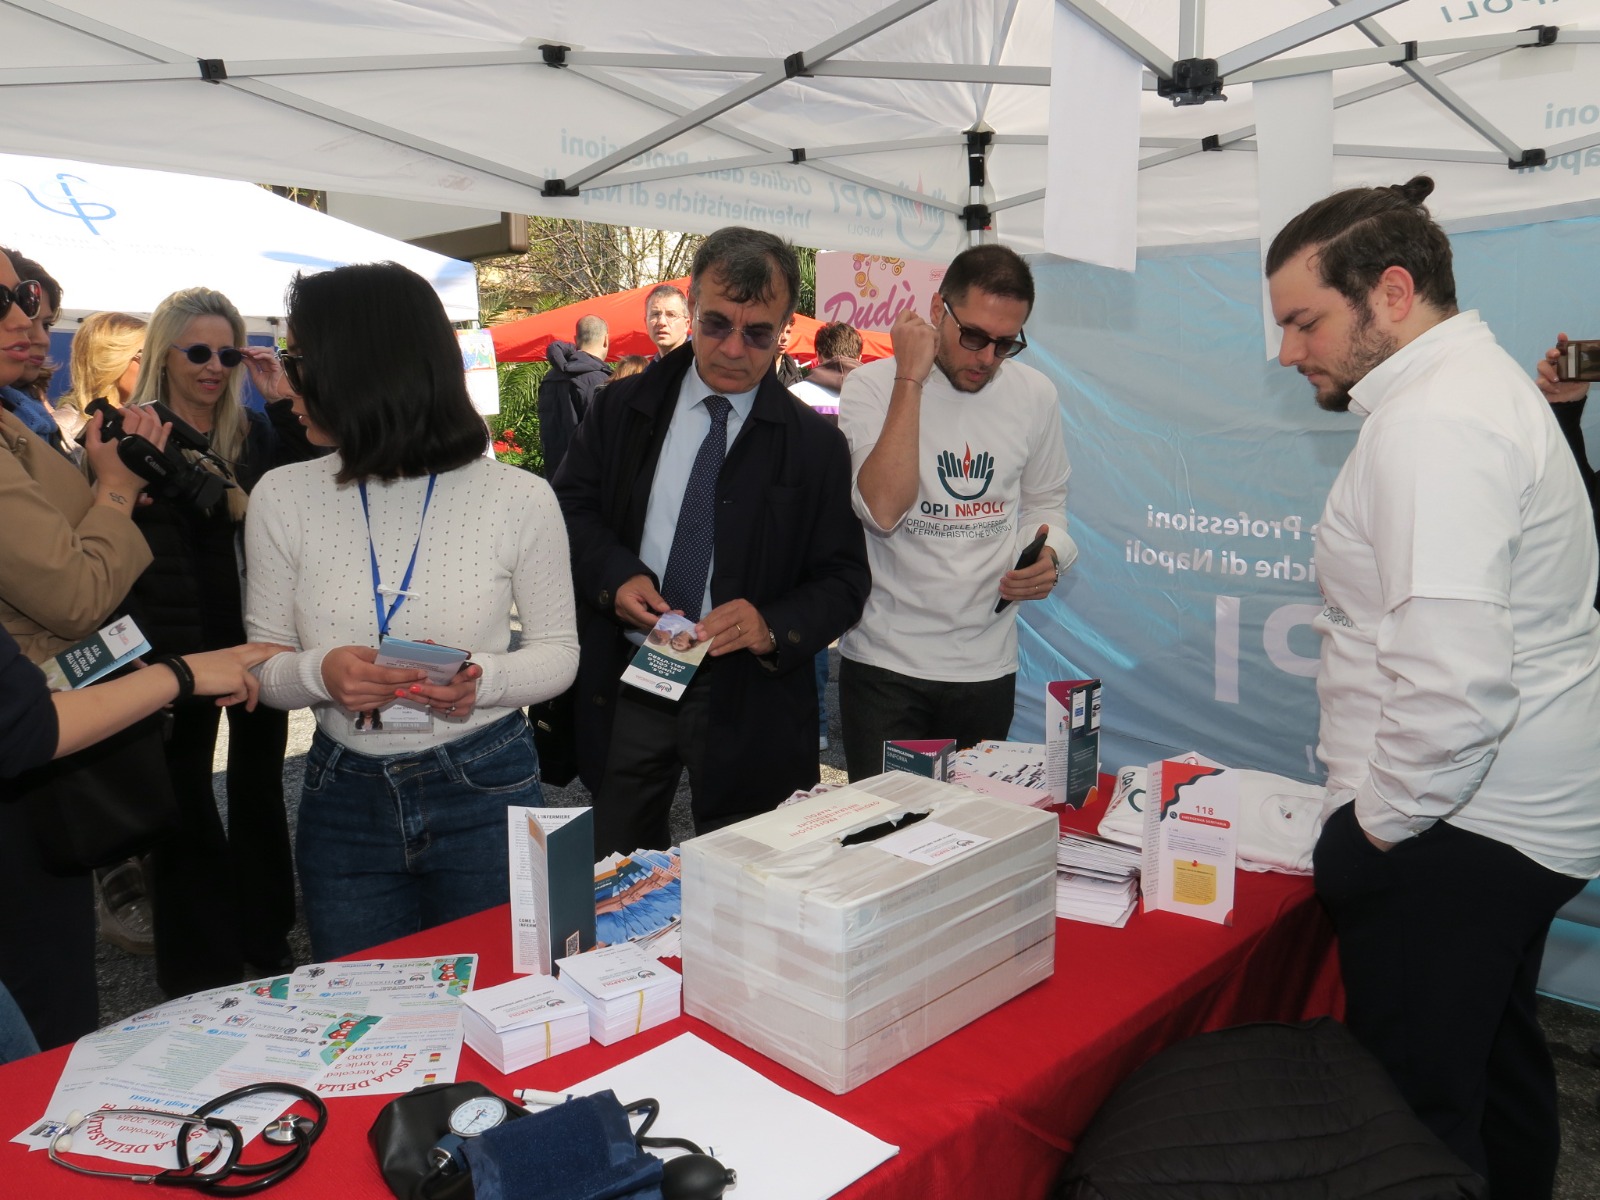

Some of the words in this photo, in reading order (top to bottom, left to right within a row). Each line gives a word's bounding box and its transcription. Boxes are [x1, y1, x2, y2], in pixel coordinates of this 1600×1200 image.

[920, 500, 949, 518] OPI
[955, 501, 1006, 518] NAPOLI
[906, 518, 941, 532] ORDINE
[942, 523, 973, 532] DELLE
[904, 526, 985, 539] INFERMIERISTICHE
[647, 656, 667, 667] COLLO
[648, 662, 675, 674] TUMORE
[1195, 805, 1214, 816] 118
[345, 1060, 379, 1070] Aprile
[316, 1078, 370, 1092] DELLA
[129, 1093, 162, 1105] Artisti
[164, 1098, 190, 1109] degli
[149, 1118, 180, 1130] Aprile
[101, 1137, 150, 1154] DELLA
